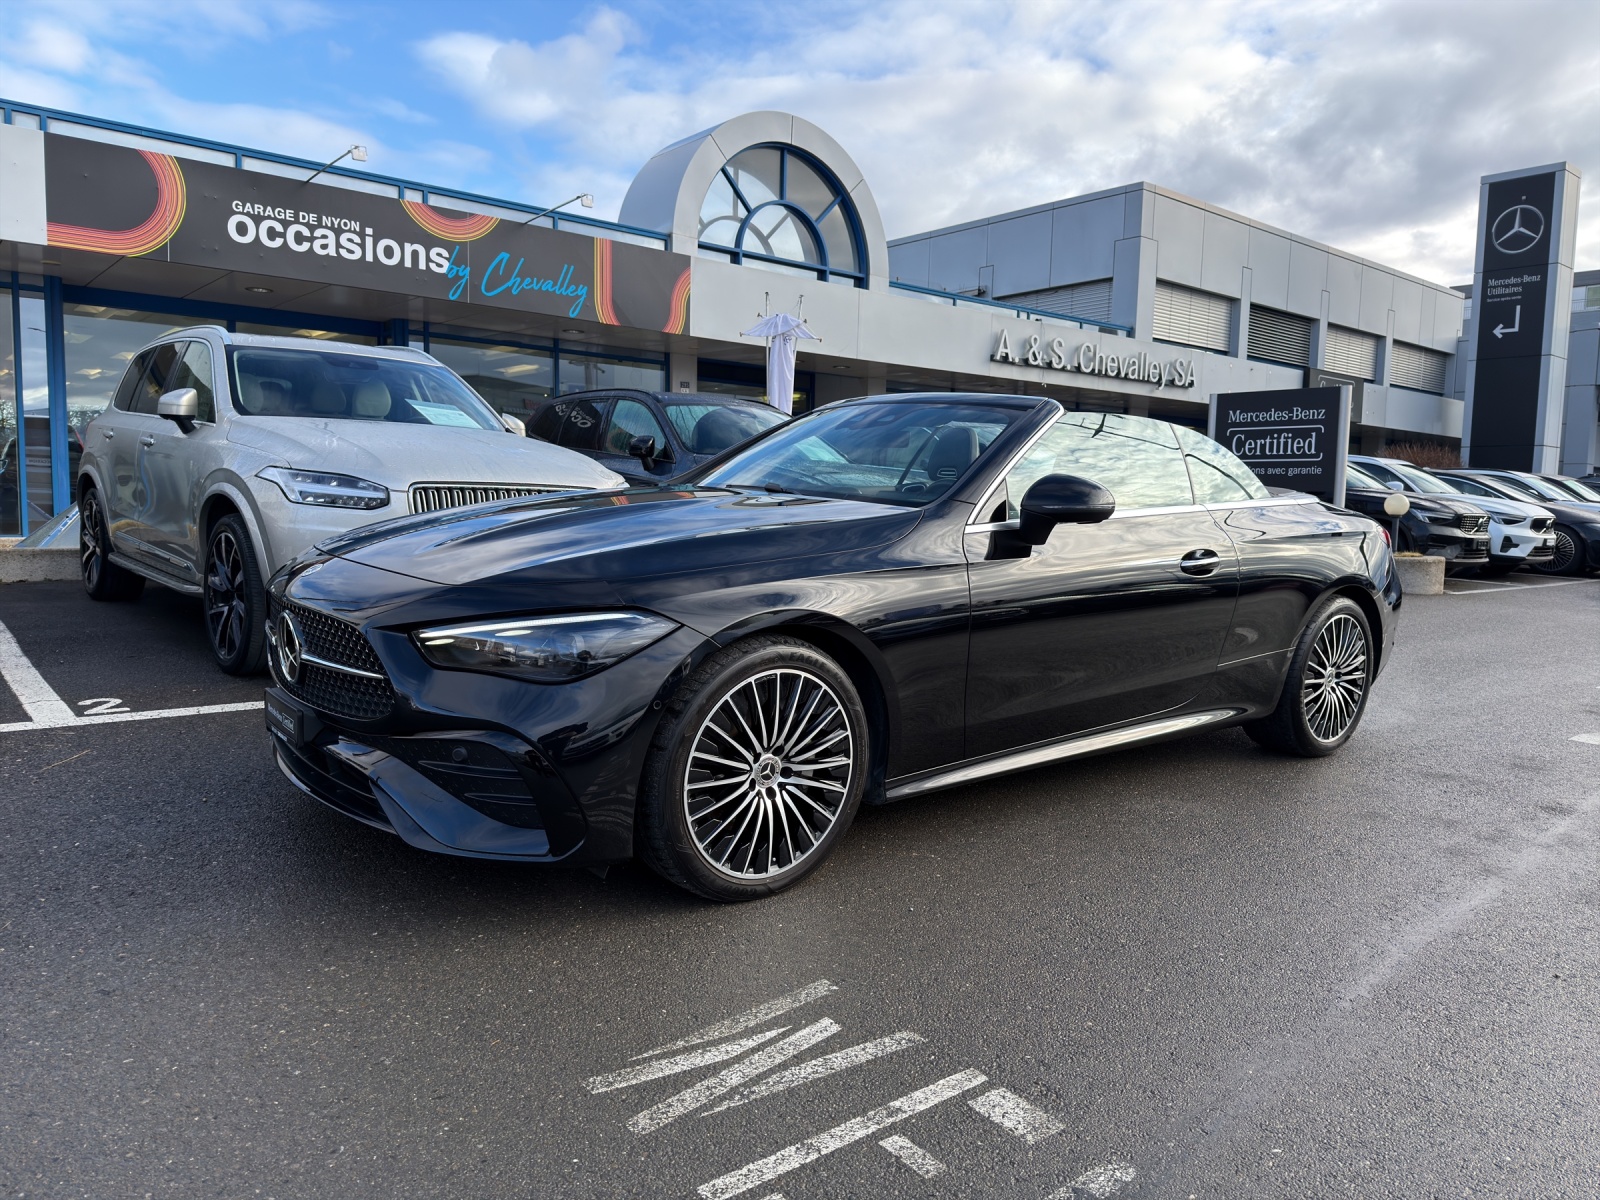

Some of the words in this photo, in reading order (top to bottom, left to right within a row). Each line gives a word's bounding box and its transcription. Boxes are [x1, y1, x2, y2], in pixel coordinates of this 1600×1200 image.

[232, 200, 295, 221] GARAGE
[299, 211, 318, 225] DE
[322, 216, 360, 232] NYON
[227, 213, 450, 274] occasions
[446, 245, 471, 300] by
[481, 252, 588, 318] Chevalley
[1487, 274, 1541, 287] Mercedes-Benz
[1487, 285, 1523, 296] Utilitaires
[996, 328, 1020, 363] A.
[1027, 334, 1043, 366] &
[1051, 337, 1071, 371] S.
[1078, 342, 1170, 391] Chevalley
[1174, 358, 1197, 388] SA
[1227, 407, 1326, 423] Mercedes-Benz
[1232, 432, 1317, 456] Certified
[1267, 467, 1286, 475] avec
[1287, 466, 1323, 477] garantie
[77, 697, 131, 715] 2
